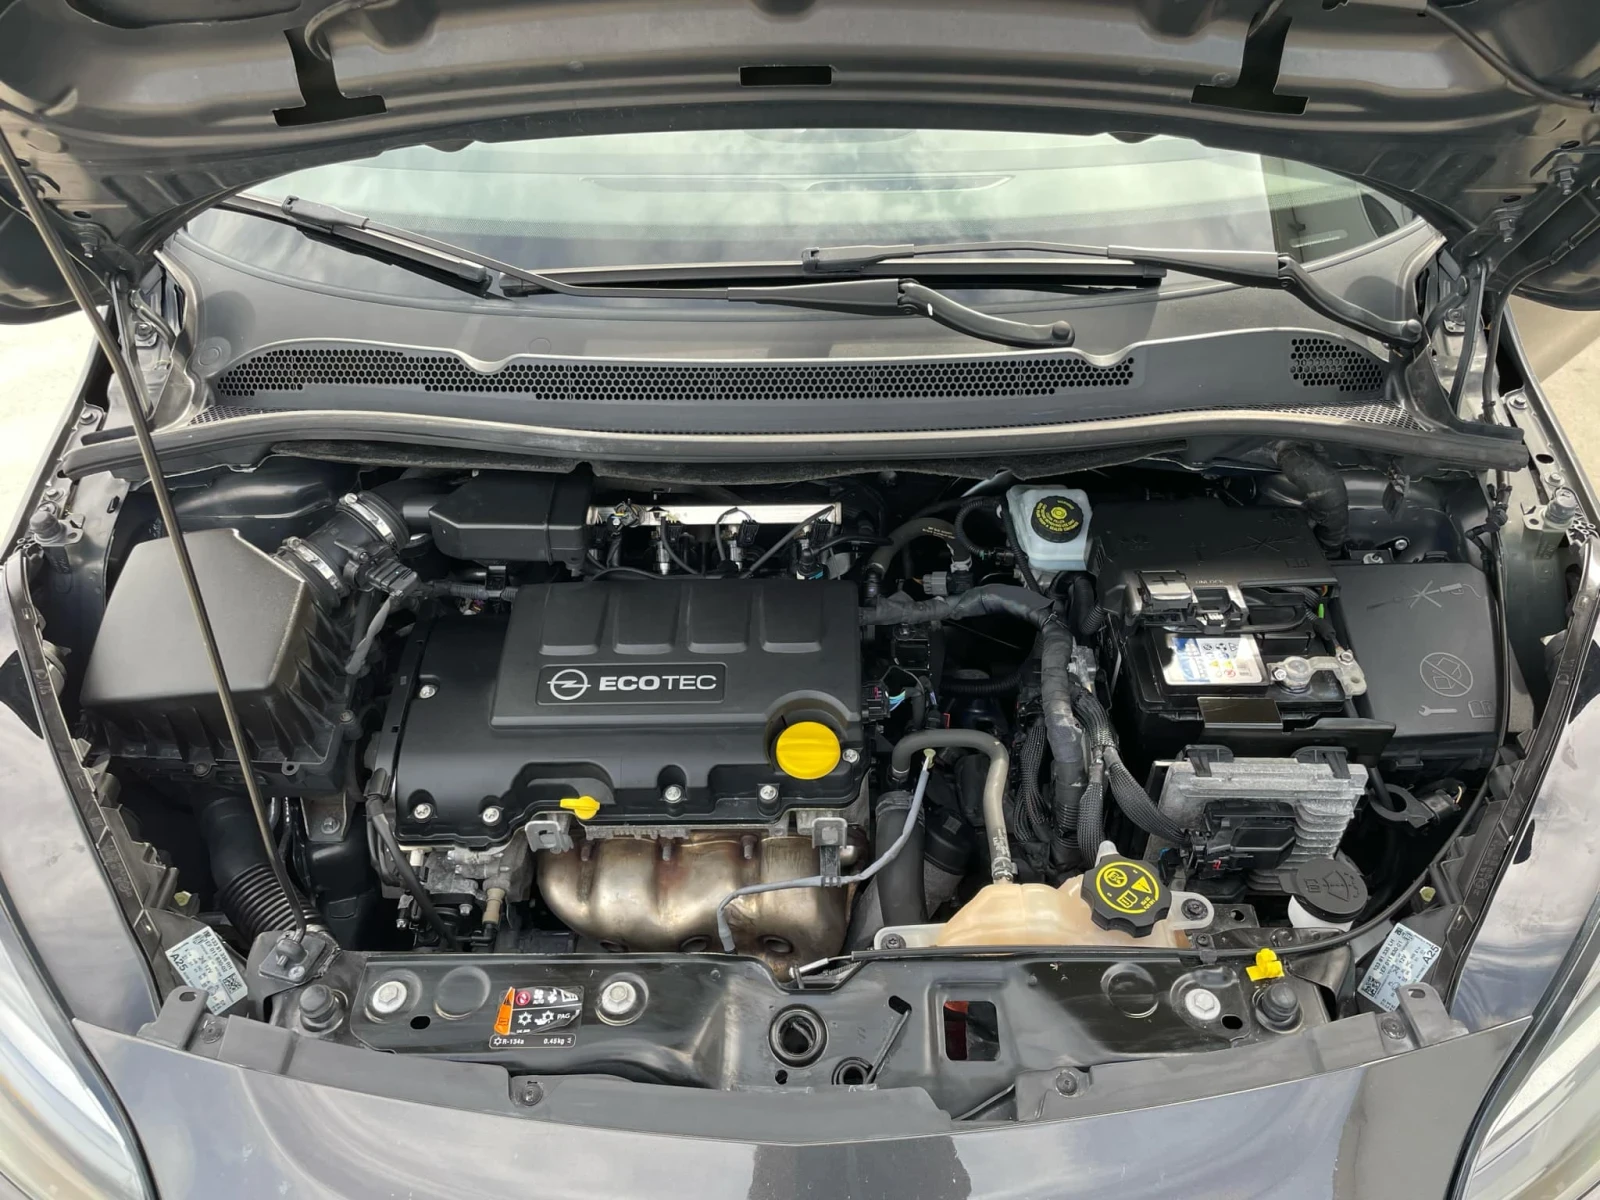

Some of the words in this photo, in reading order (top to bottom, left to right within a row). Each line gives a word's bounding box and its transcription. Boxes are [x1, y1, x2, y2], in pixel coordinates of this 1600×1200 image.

[599, 675, 717, 691] ECOTEC
[170, 953, 188, 972] A25
[1399, 954, 1407, 963] 12V
[1422, 945, 1440, 964] A25
[204, 964, 213, 974] 12V
